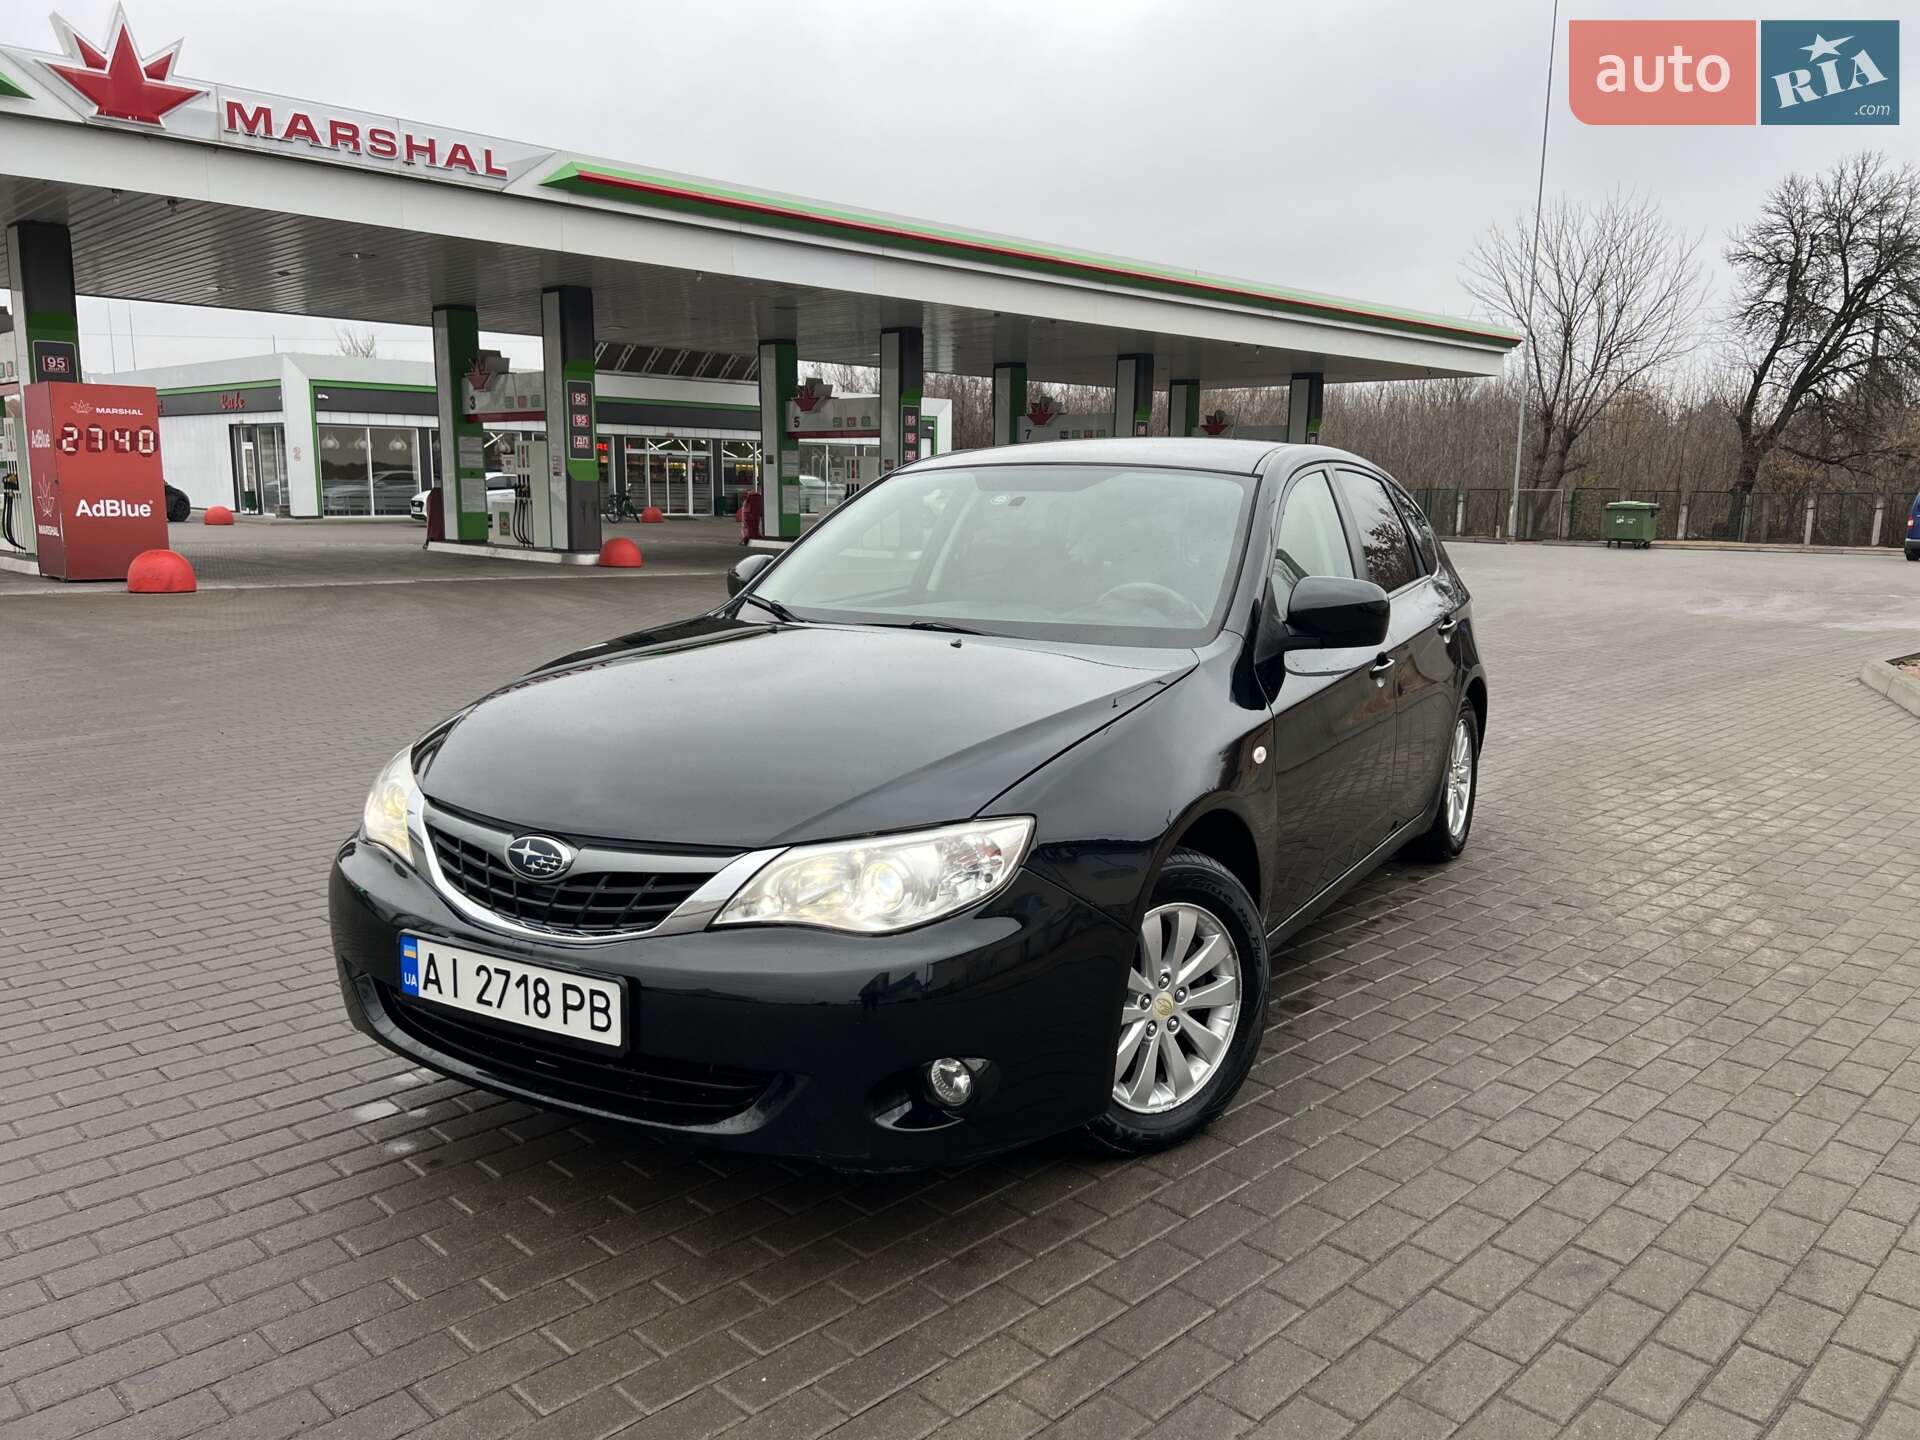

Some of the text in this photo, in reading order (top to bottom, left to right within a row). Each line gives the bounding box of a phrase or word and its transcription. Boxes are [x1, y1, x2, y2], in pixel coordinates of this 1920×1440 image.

[224, 99, 508, 179] MARSHAL
[47, 356, 66, 369] 95
[470, 395, 476, 410] 3
[575, 393, 587, 402] 95
[95, 406, 143, 416] MARSHAL
[576, 415, 587, 425] 95
[794, 416, 801, 428] 5
[1025, 429, 1032, 440] 7
[75, 499, 152, 518] AdBlue
[404, 972, 418, 987] UA
[422, 953, 612, 1033] AI 2718 PB
